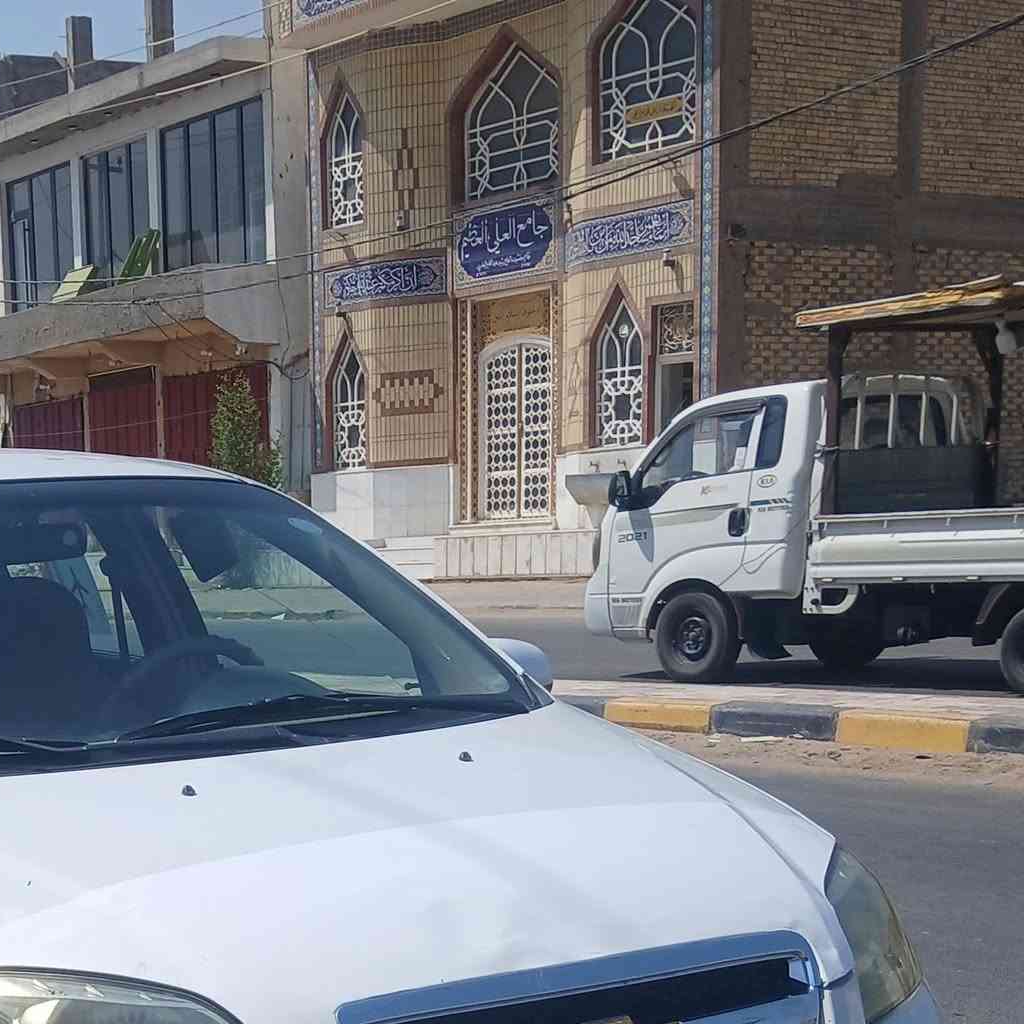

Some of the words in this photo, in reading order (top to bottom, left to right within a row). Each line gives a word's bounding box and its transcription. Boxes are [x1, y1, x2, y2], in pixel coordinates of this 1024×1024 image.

[461, 217, 488, 263] العظيم
[487, 215, 517, 255] العلي
[517, 209, 549, 248] جامع
[617, 531, 648, 544] 2021
